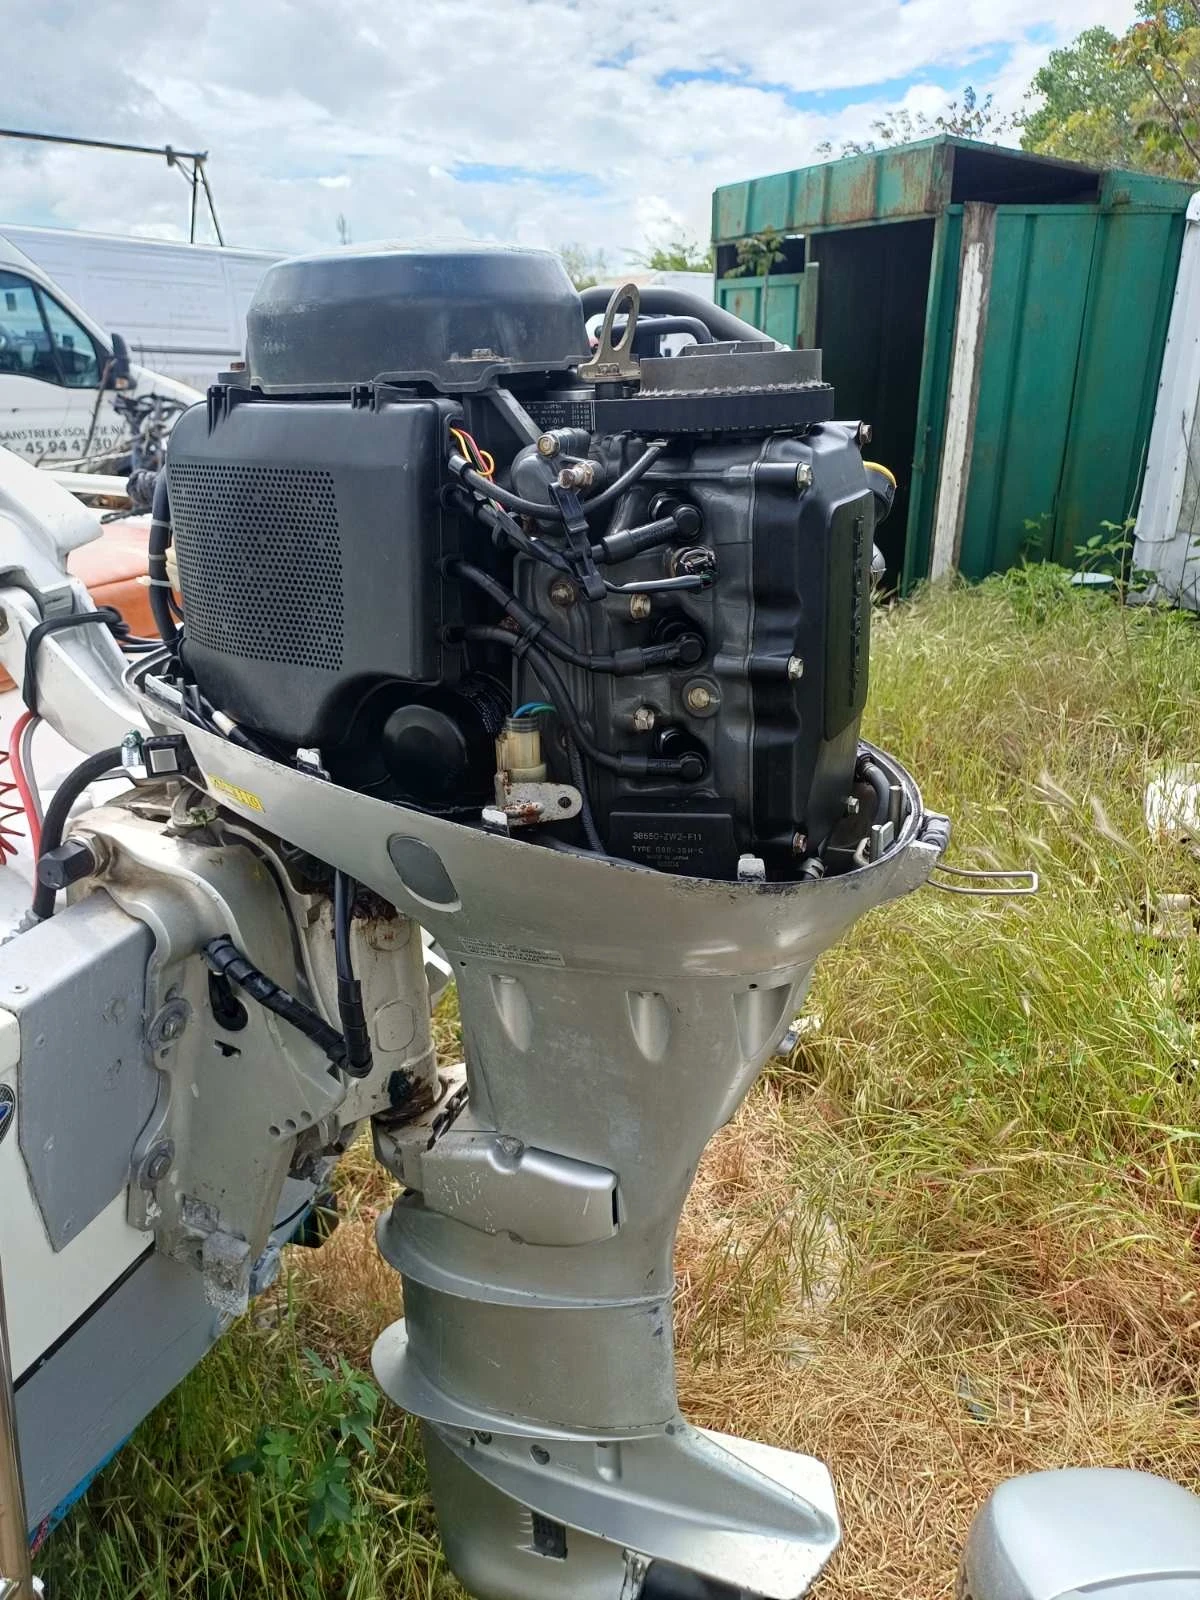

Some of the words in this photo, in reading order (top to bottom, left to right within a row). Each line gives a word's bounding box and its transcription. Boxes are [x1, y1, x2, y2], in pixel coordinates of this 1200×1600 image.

[25, 442, 44, 454] 45
[48, 440, 67, 453] 94
[631, 845, 651, 854] TYPE
